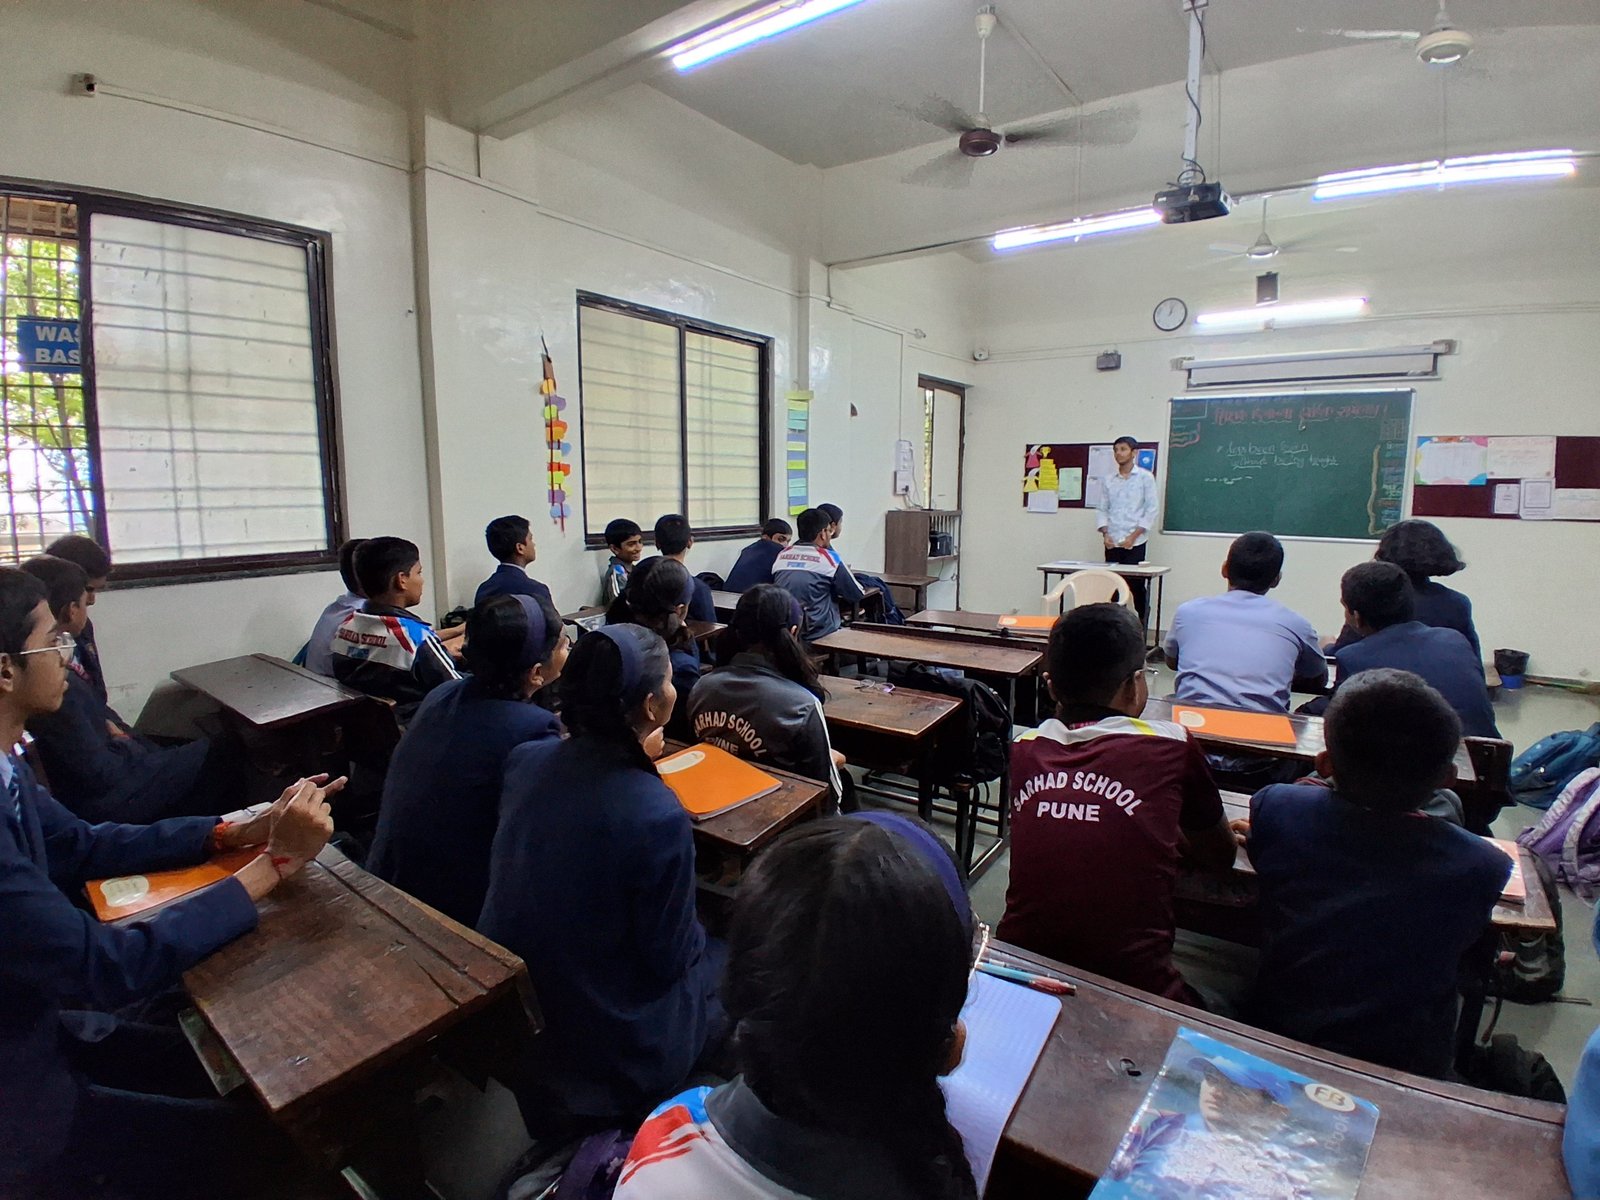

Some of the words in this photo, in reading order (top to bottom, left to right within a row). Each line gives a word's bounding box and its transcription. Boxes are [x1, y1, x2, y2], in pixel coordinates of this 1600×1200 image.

[35, 348, 80, 364] BAS
[728, 714, 767, 757] SCHOOL
[1013, 772, 1068, 812] SARHAD
[1072, 771, 1142, 816] SCHOOL
[1037, 801, 1101, 822] PUNE
